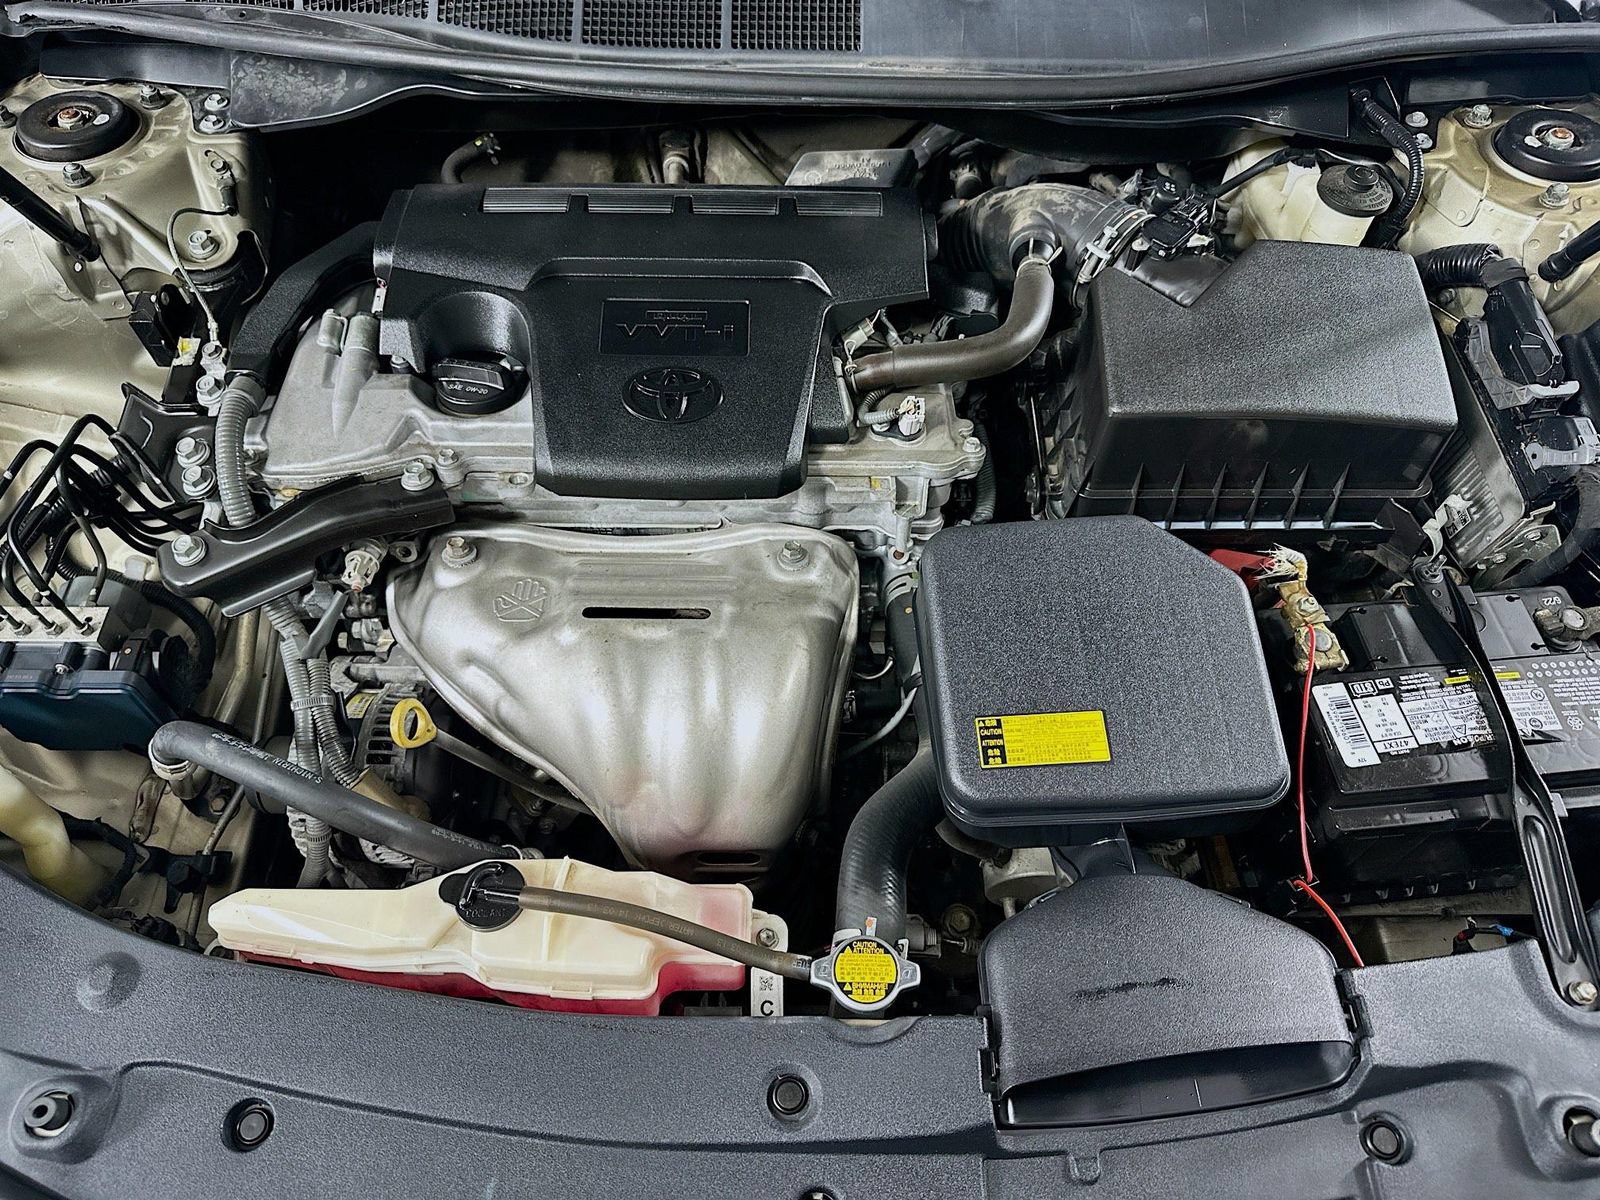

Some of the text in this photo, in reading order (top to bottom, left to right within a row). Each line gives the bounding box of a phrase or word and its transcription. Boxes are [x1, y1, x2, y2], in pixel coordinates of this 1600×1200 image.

[447, 383, 489, 395] SAE 0W-20
[980, 728, 1002, 736] CAUTION
[981, 739, 1004, 747] ATTENTION
[1382, 740, 1409, 750] 47EXT
[853, 947, 885, 955] ATTENTION
[760, 1000, 774, 1016] C
